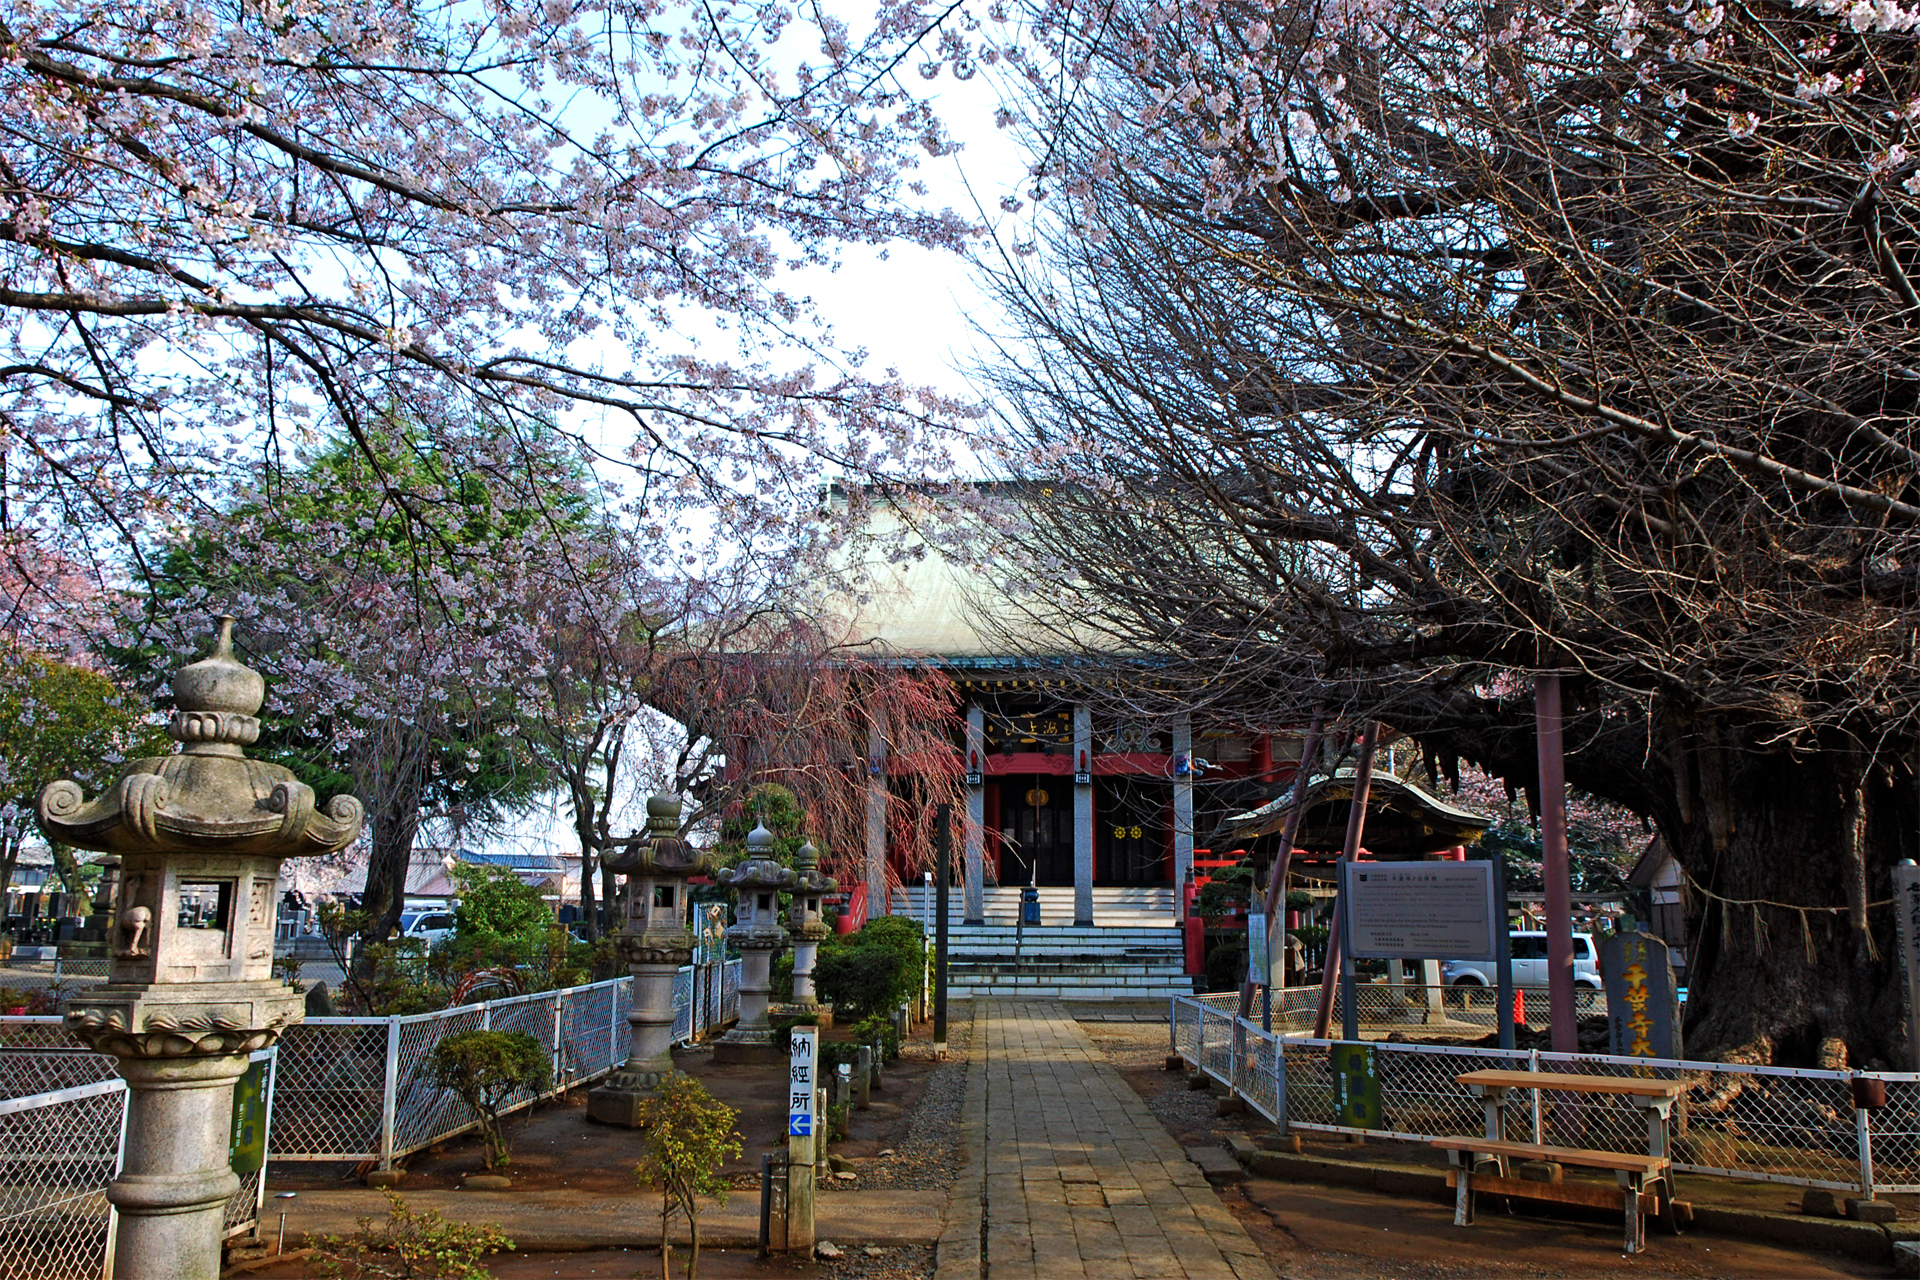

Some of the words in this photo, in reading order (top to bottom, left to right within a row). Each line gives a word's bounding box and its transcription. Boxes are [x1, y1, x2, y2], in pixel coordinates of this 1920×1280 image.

[790, 1037, 811, 1110] 納經所
[1365, 1046, 1375, 1078] 千葉寺
[260, 1063, 269, 1103] 千葉寺
